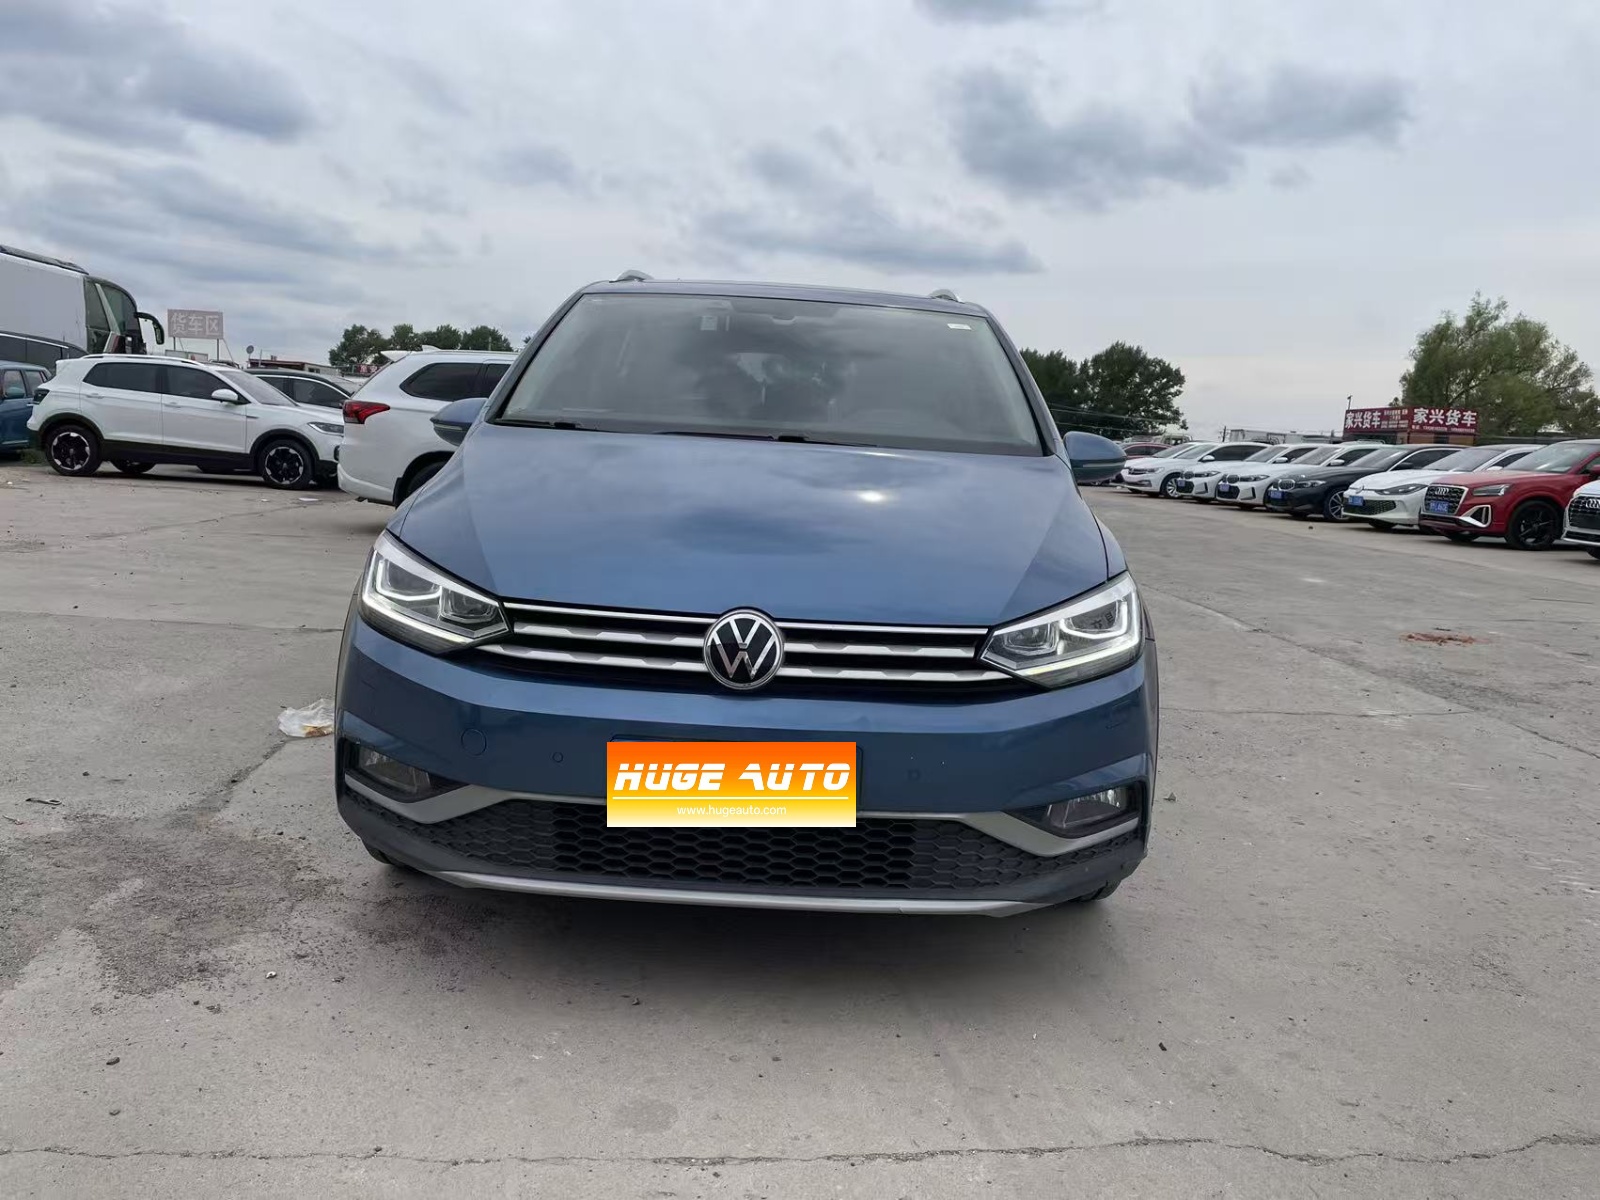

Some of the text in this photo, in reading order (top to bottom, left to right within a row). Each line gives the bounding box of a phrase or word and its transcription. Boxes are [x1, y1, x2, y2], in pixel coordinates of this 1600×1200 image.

[170, 311, 219, 336] 货车区
[1345, 411, 1381, 429] 家兴货车
[1413, 407, 1477, 426] 家兴货车
